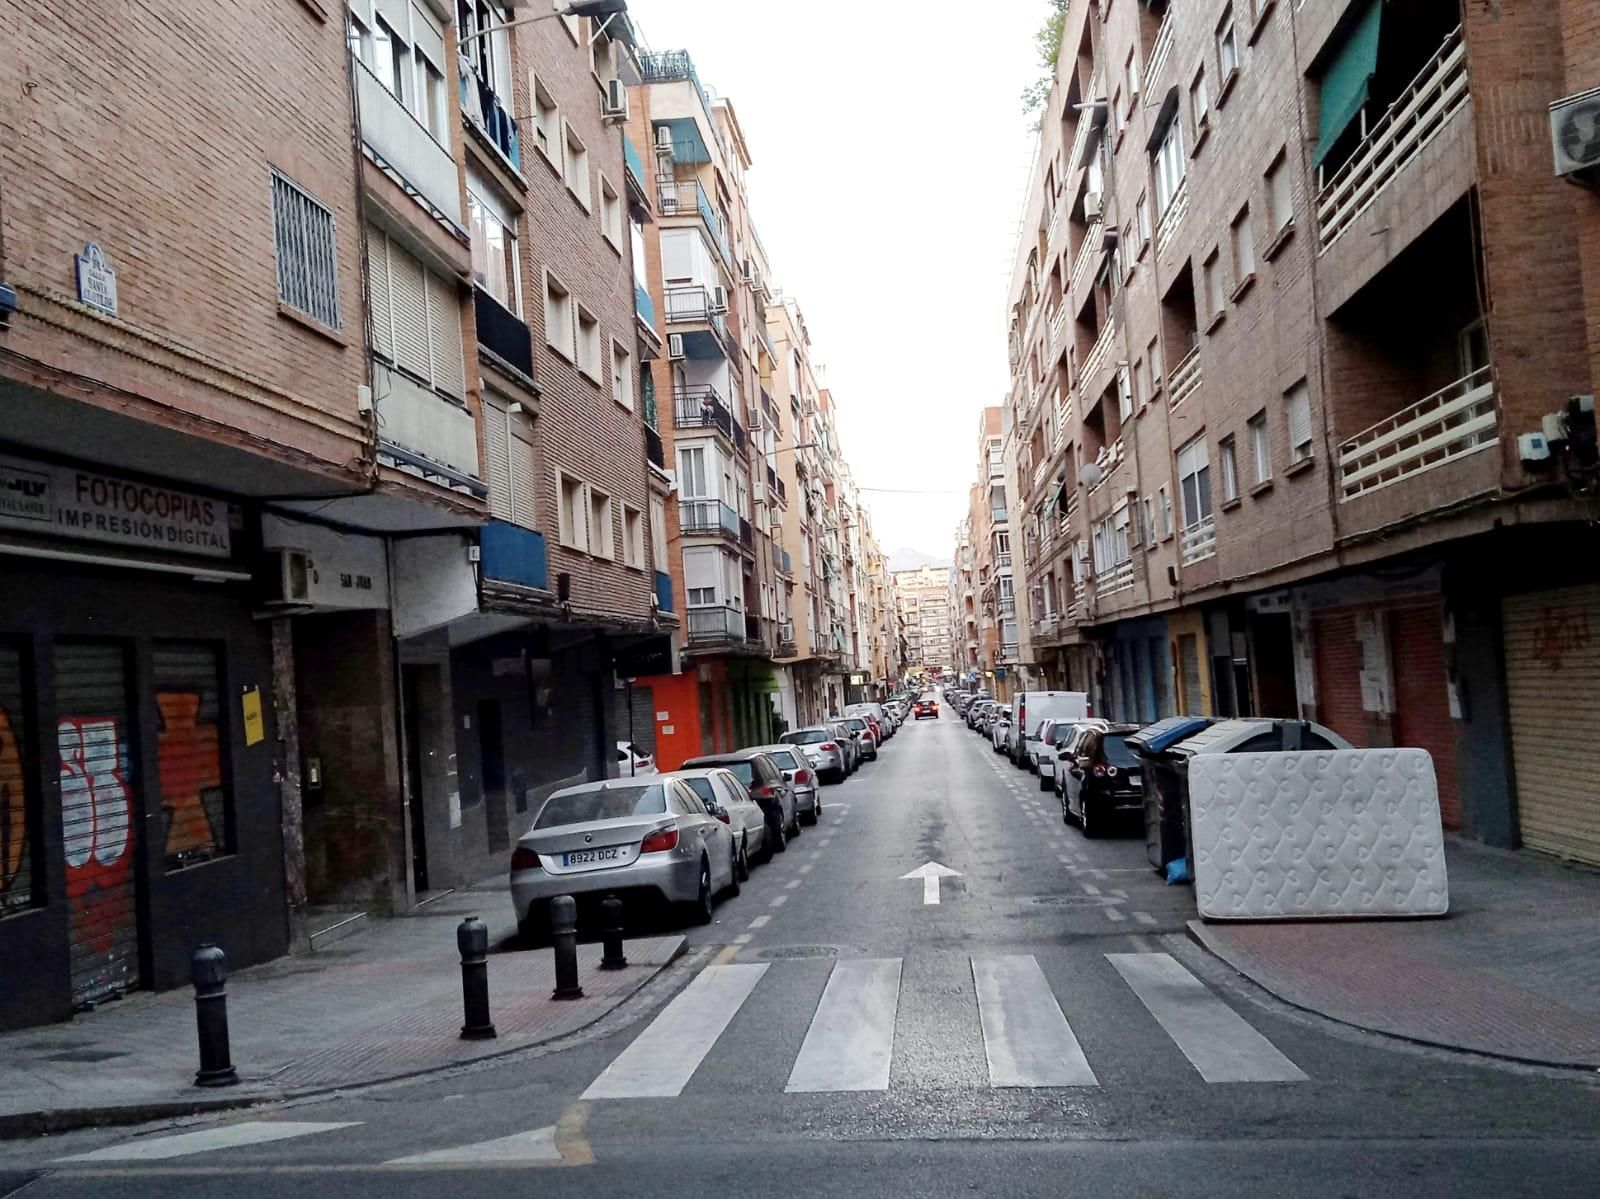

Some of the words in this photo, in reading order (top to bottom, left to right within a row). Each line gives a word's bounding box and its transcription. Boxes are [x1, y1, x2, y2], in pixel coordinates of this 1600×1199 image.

[88, 277, 107, 294] SANTA
[76, 473, 215, 527] FOTOCOPIAS
[58, 508, 163, 540] IMPRESIÓN
[167, 526, 228, 550] DIGITAL
[340, 572, 353, 588] SAN
[570, 852, 595, 864] 8922
[598, 849, 617, 860] DCZ
